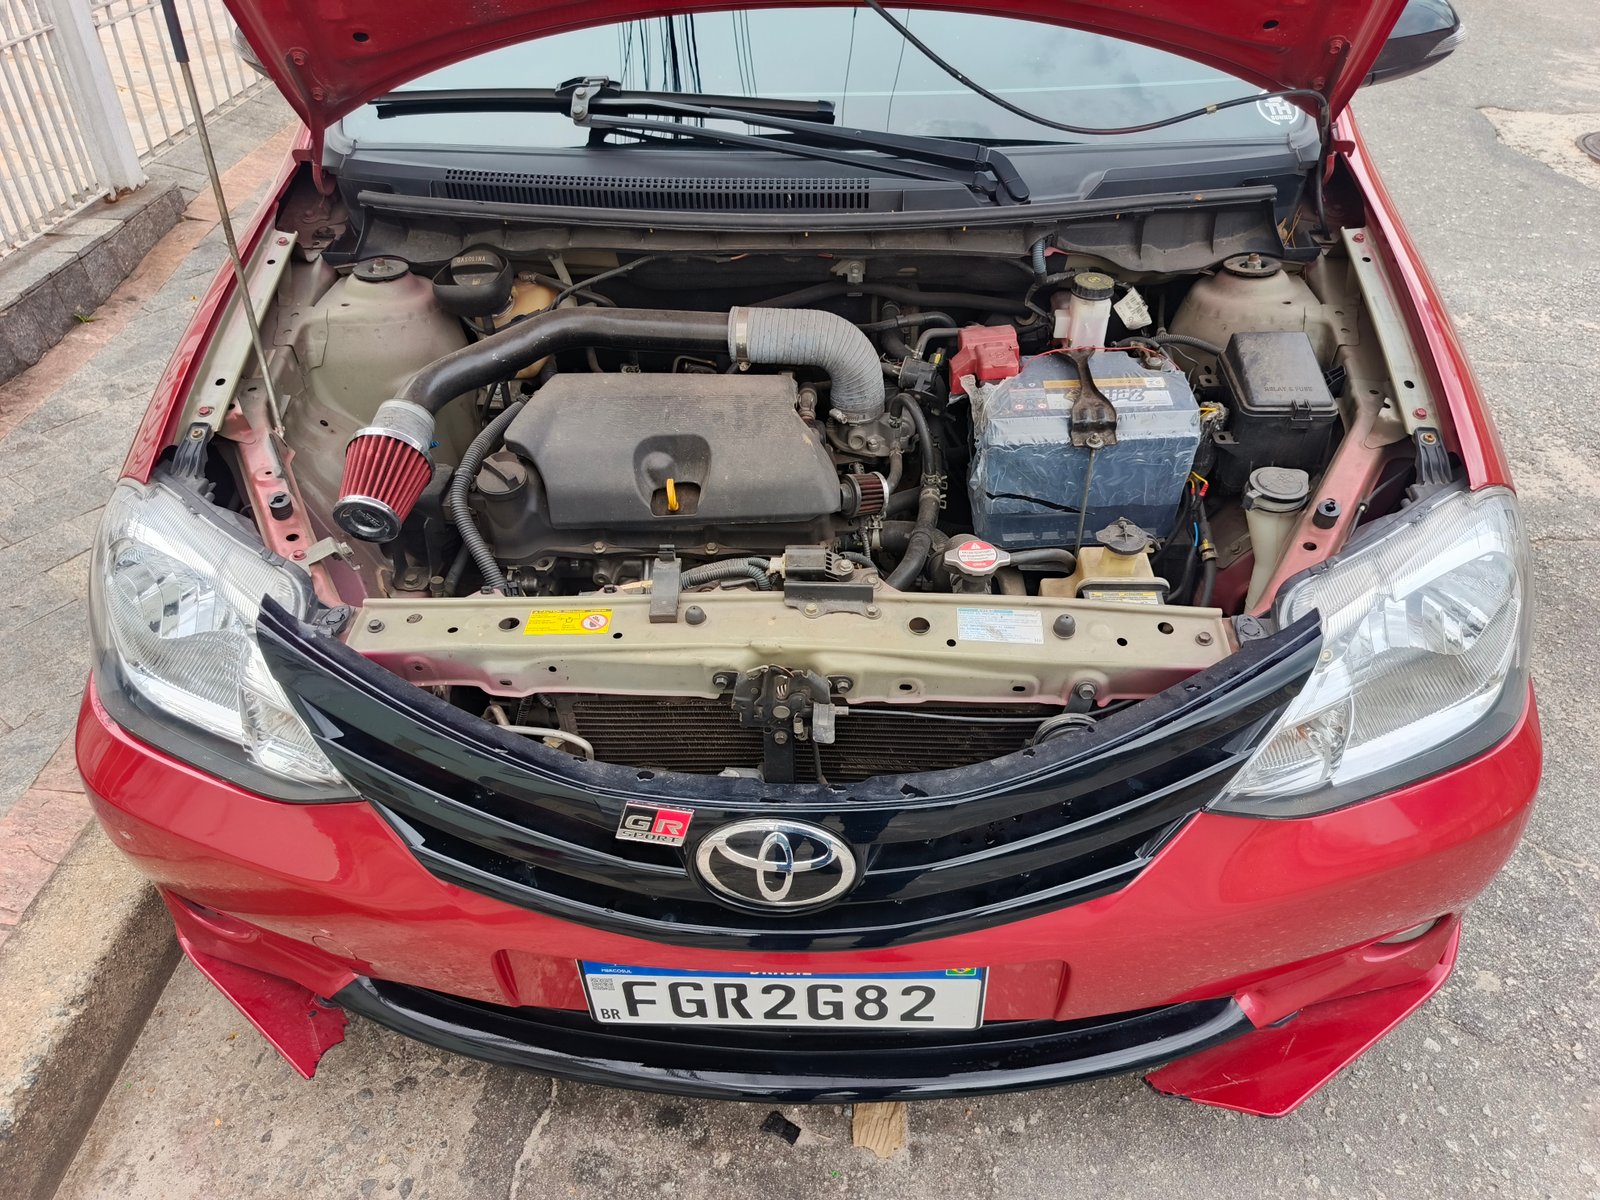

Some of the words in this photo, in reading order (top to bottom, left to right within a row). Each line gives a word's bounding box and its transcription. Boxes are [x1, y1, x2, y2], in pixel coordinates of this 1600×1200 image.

[1264, 102, 1292, 115] TH
[456, 255, 487, 264] GASOLINA
[624, 814, 684, 835] GR
[622, 830, 680, 843] SPORT
[621, 981, 936, 1021] FGR2G82
[600, 1008, 622, 1020] BR
